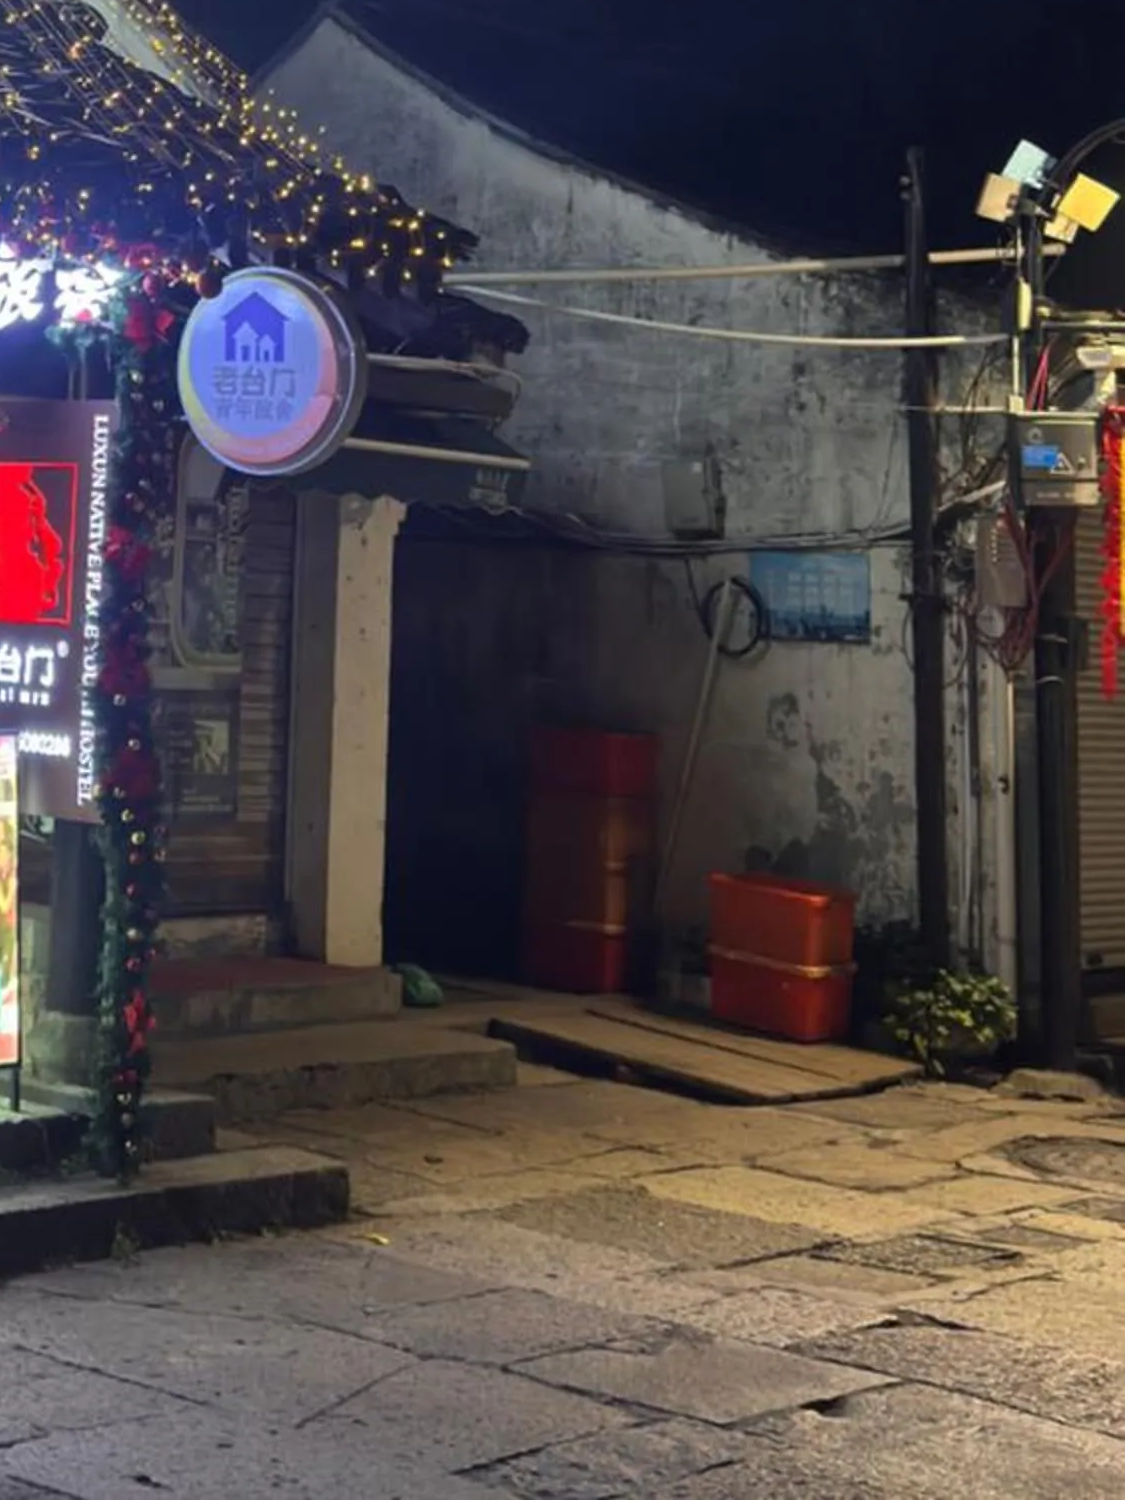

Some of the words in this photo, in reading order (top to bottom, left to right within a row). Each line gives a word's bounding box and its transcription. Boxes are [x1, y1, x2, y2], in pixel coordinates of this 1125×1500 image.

[213, 365, 296, 398] 老台门
[91, 414, 110, 487] LUXUN
[87, 490, 106, 568] NATIVE
